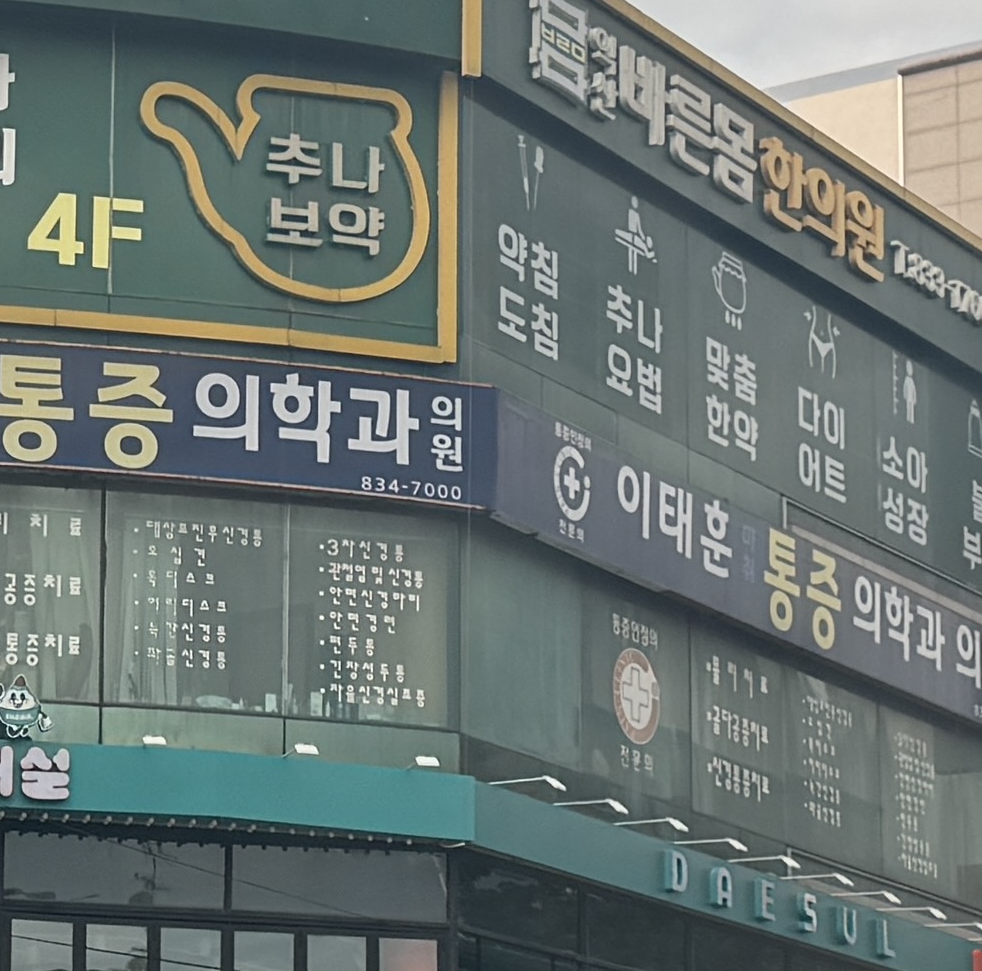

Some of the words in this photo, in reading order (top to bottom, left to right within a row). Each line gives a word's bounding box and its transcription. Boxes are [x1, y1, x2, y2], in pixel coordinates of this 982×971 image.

[265, 134, 385, 193] 추나
[588, 27, 618, 121] 익산
[618, 45, 758, 204] 바른몸
[759, 136, 884, 282] 한의원
[27, 192, 144, 269] 4F
[265, 197, 385, 256] 보약
[498, 223, 559, 300] 약침
[498, 286, 559, 361] 도침
[606, 284, 663, 354] 추나
[606, 343, 662, 415] 요법
[705, 336, 758, 406] 맞춤
[192, 372, 419, 466] 의학과
[430, 395, 464, 473] 의원
[705, 395, 759, 462] 한약
[797, 386, 845, 450] 다이
[361, 476, 462, 501] 834-7000
[797, 443, 847, 504] 어트
[883, 436, 928, 493] 소아
[883, 488, 928, 546] 성장
[618, 465, 732, 578] 이태훈
[764, 528, 841, 650] 통증
[853, 576, 945, 672] 의학과
[665, 849, 896, 958] DAESUL
